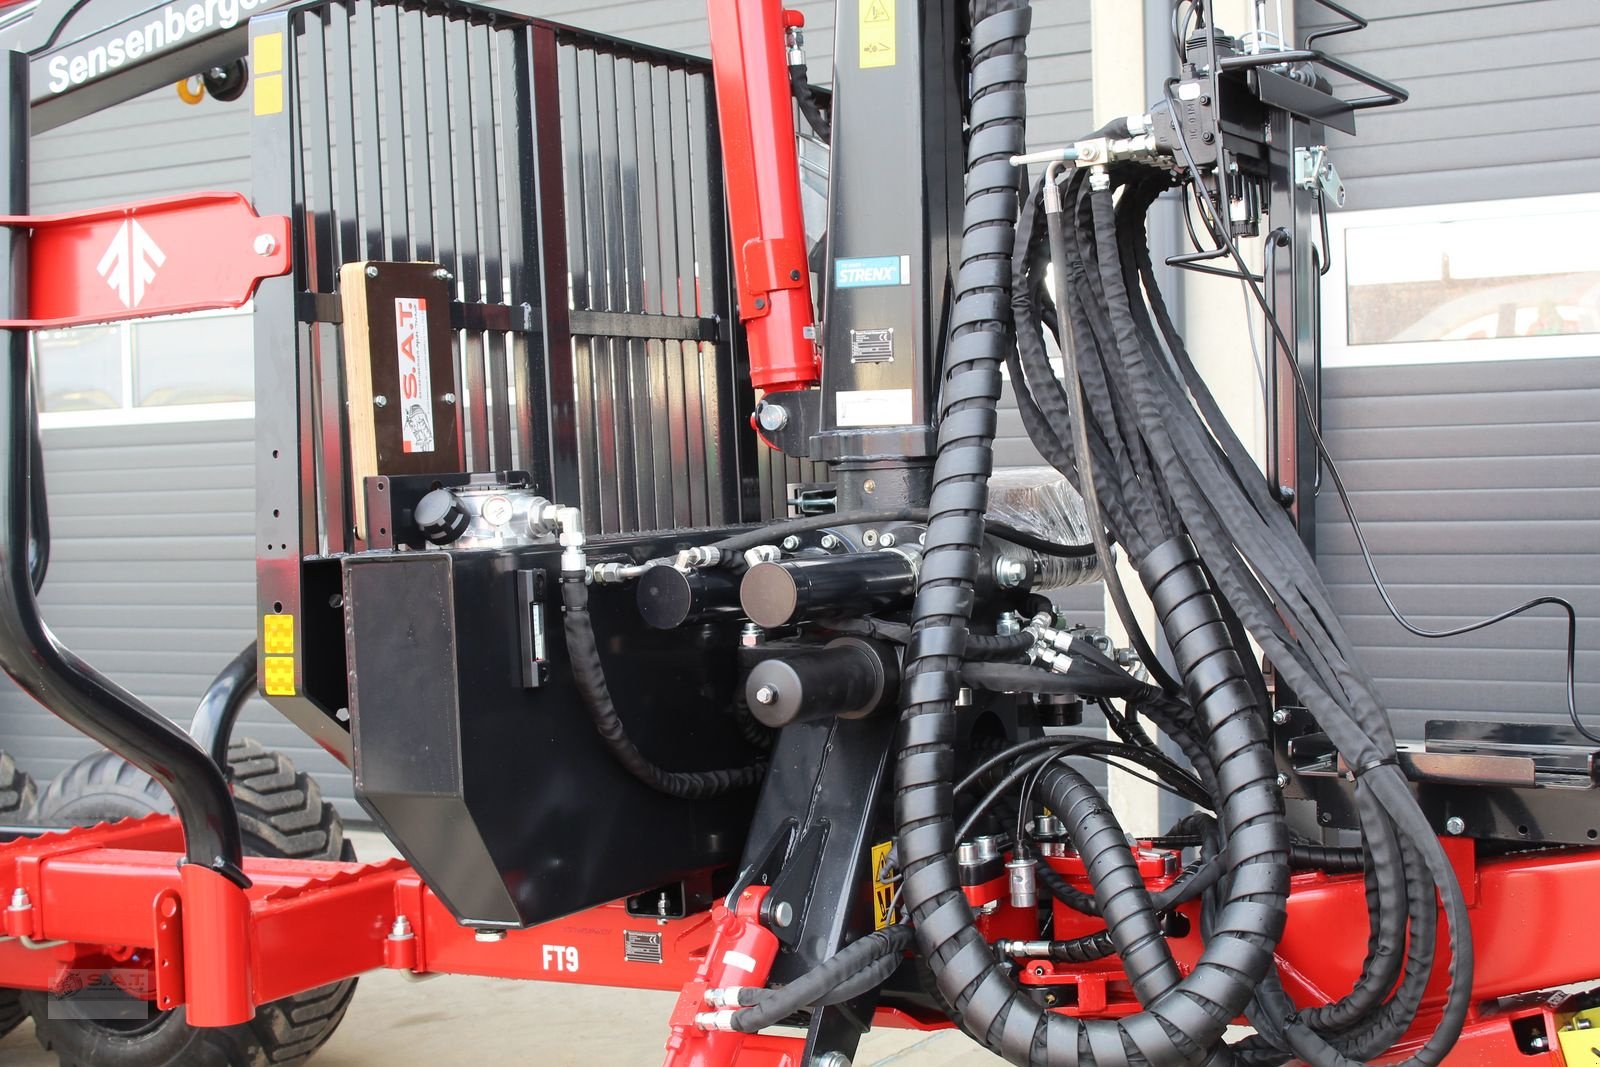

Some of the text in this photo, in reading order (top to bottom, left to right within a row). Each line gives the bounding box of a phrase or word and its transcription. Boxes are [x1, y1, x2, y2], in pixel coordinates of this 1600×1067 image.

[49, 0, 268, 93] Sensenberg
[399, 302, 418, 399] S.A.T.
[542, 944, 579, 972] FT9
